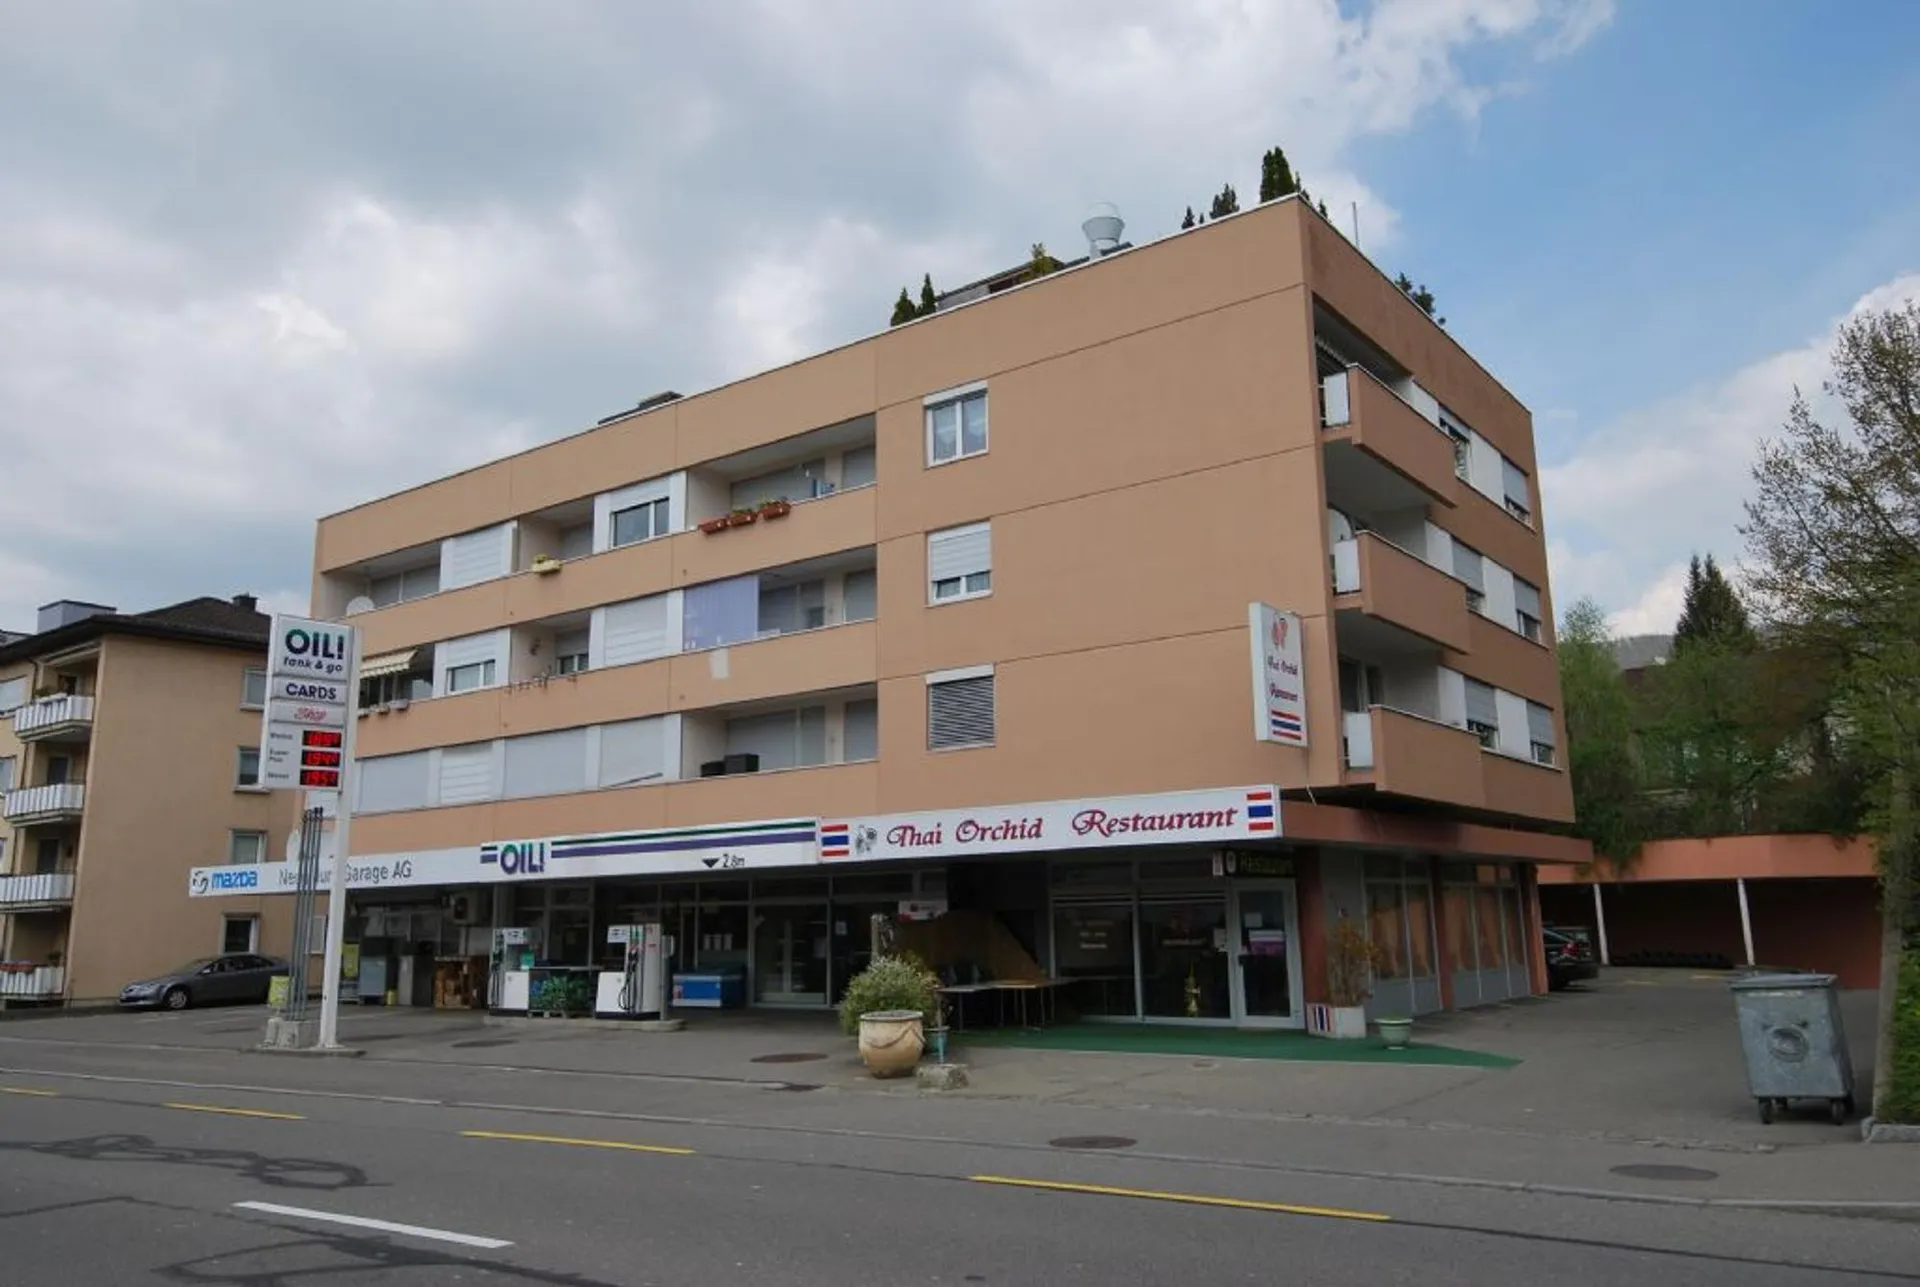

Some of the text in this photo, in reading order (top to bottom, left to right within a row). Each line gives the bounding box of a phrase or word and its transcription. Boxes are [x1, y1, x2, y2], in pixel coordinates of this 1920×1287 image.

[285, 629, 344, 660] OIL!
[283, 656, 343, 674] tank & go
[286, 682, 336, 700] CARDS
[886, 805, 1238, 848] Thai Orchid Restaurant
[393, 859, 413, 880] AG
[500, 844, 545, 875] OIL!
